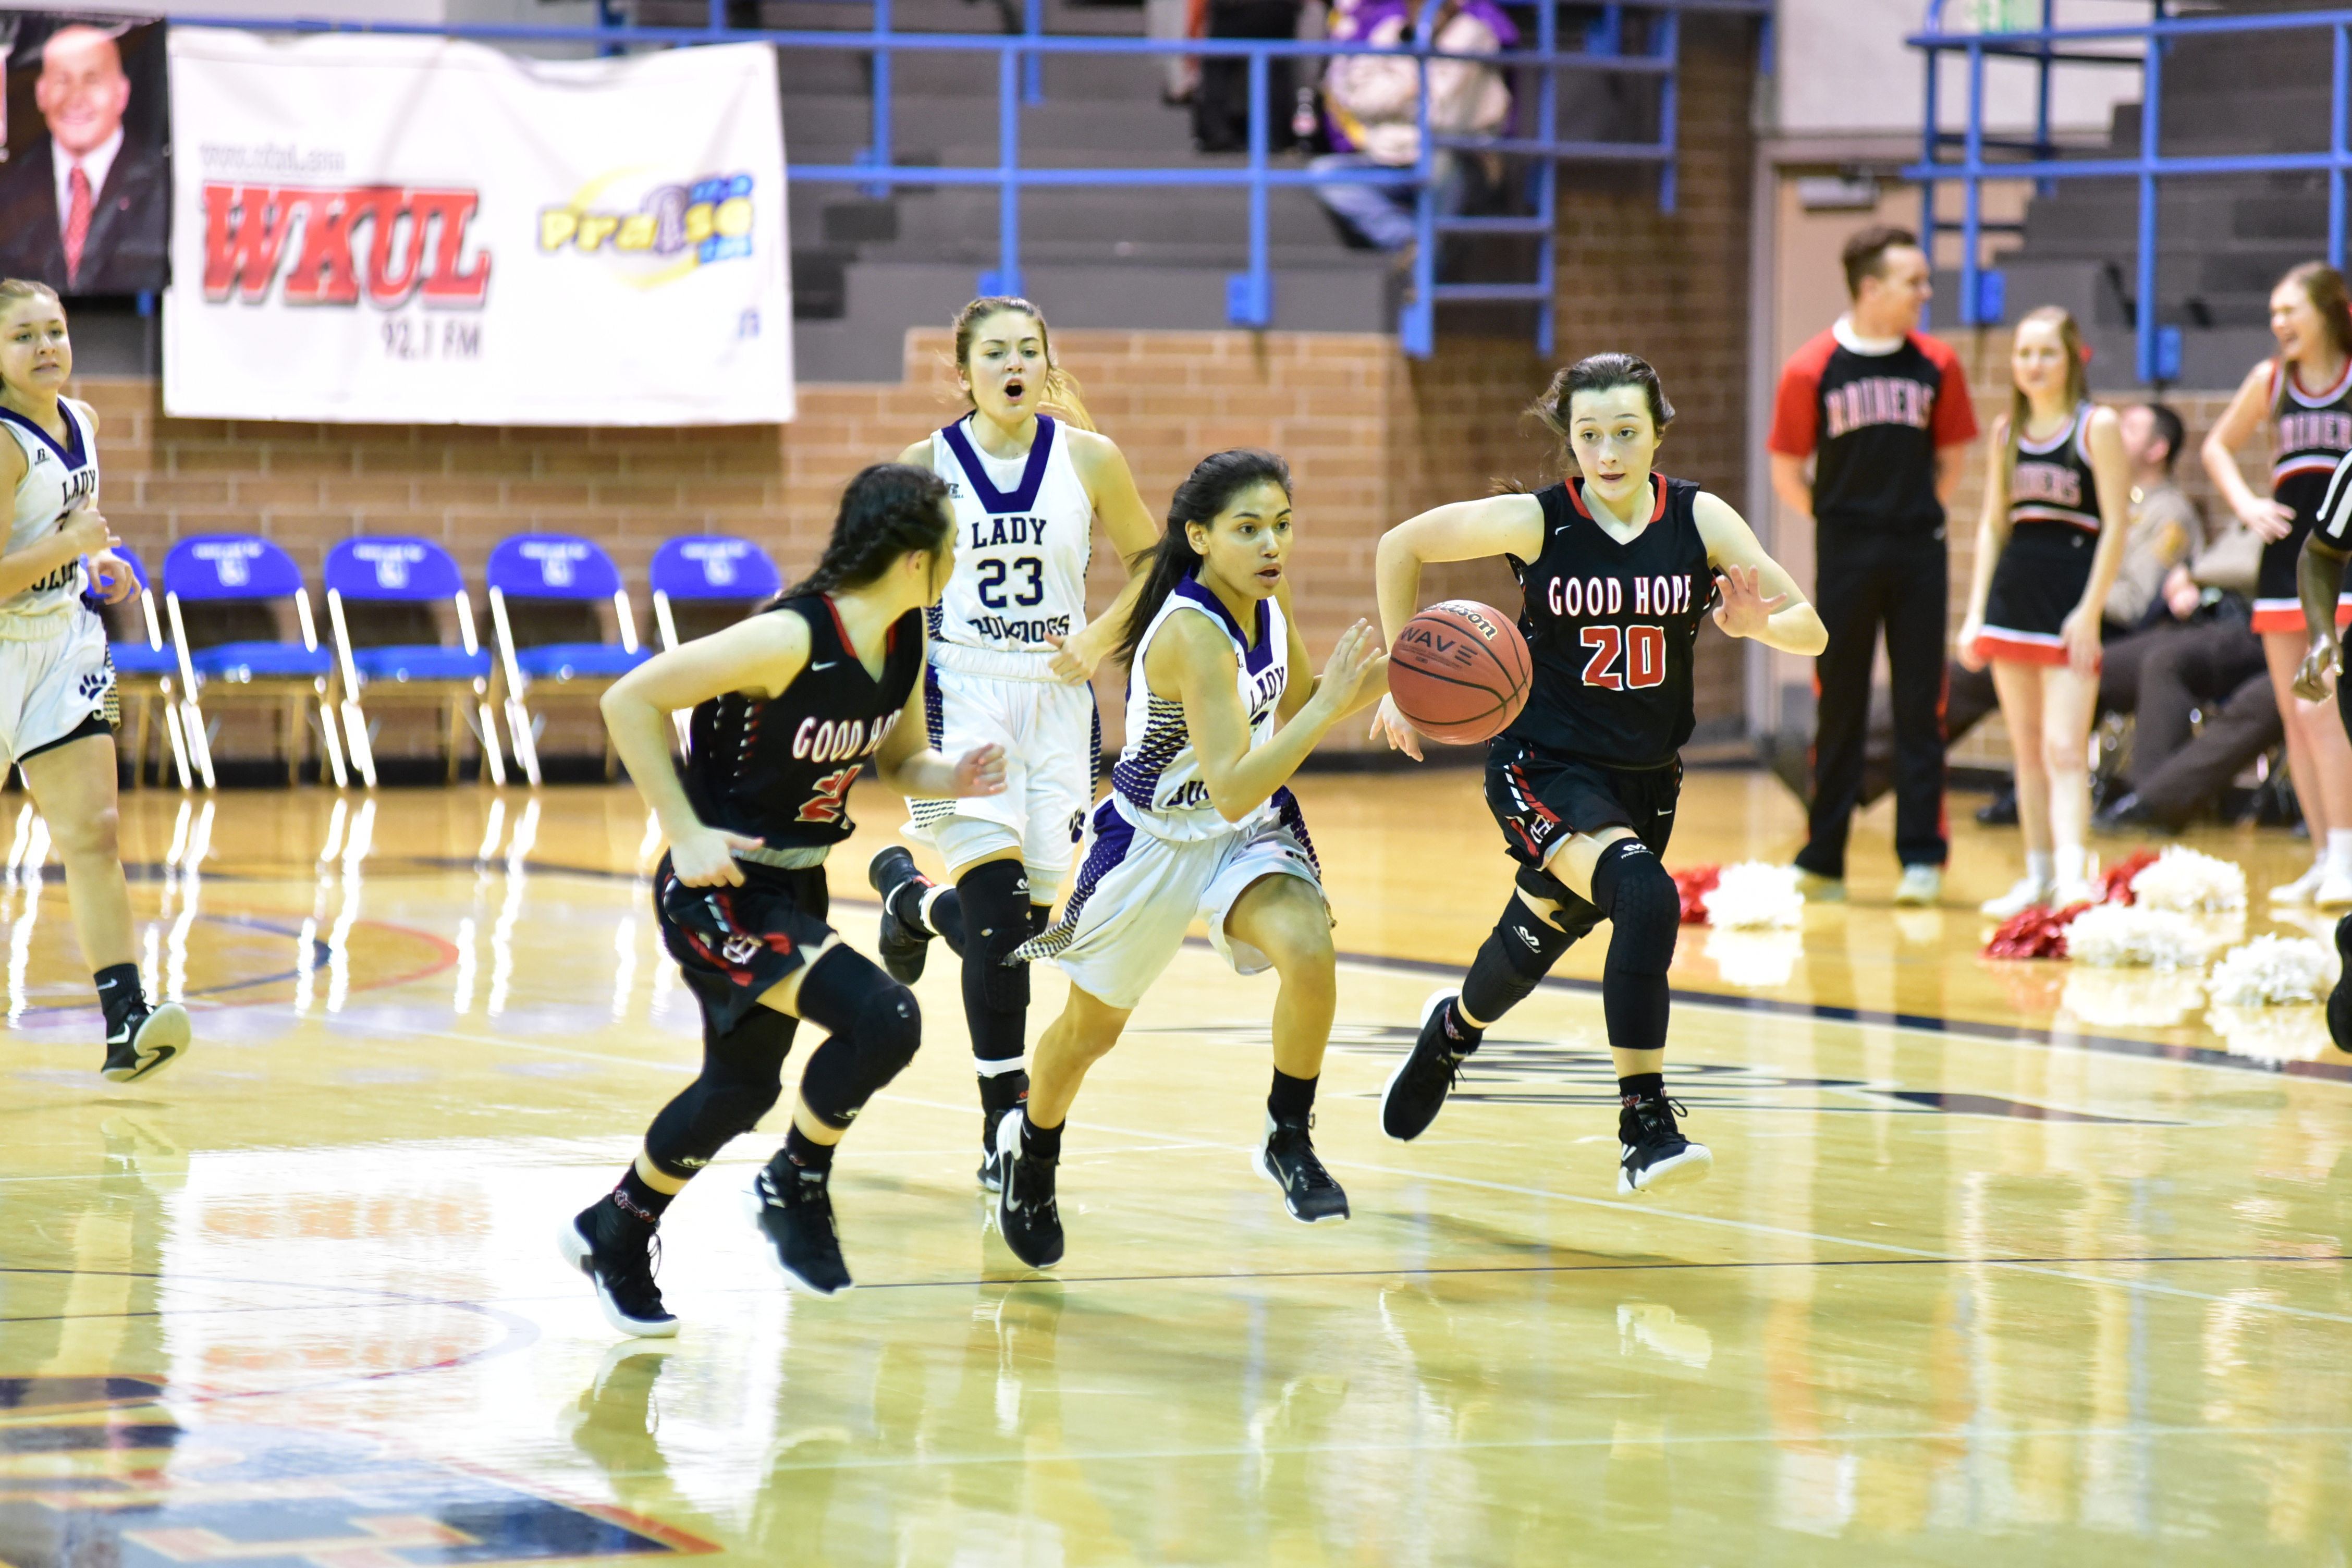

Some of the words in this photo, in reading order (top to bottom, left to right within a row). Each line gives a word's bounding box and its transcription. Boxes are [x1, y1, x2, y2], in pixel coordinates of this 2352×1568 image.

[202, 180, 492, 310] WKUL
[381, 317, 434, 360] 92.1
[443, 318, 483, 360] FM
[1824, 376, 1935, 439] RAIDERS
[62, 469, 96, 506] LADY
[972, 516, 1047, 549] LADY
[976, 556, 1044, 609] 23
[1548, 576, 1623, 616] GOOD
[1634, 575, 1692, 616] HOPE
[1400, 626, 1478, 667] WAVE
[1580, 624, 1667, 692] 20
[1248, 665, 1284, 720] LADY
[792, 716, 864, 763] GOOD
